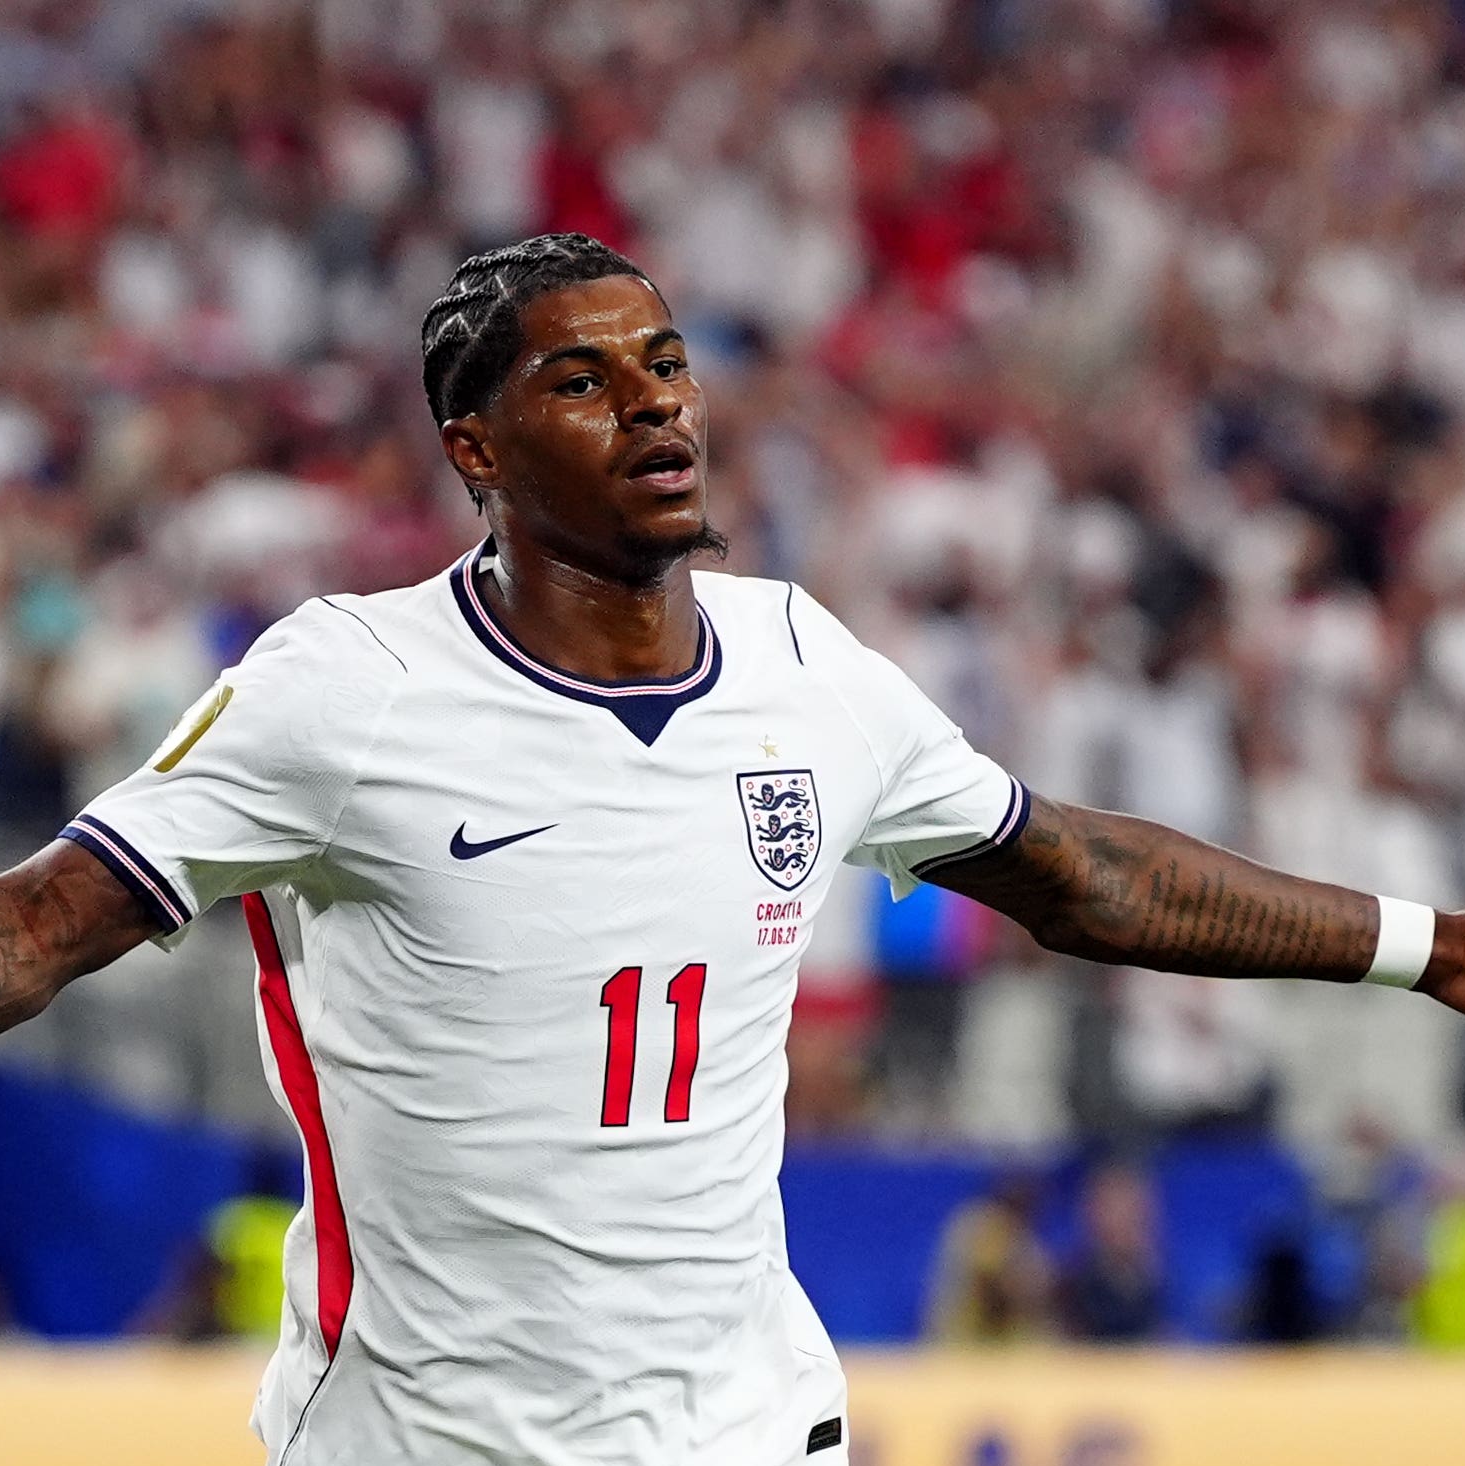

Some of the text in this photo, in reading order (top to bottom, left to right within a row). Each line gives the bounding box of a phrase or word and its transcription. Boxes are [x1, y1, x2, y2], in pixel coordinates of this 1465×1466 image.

[756, 901, 802, 921] CROATIA
[757, 926, 797, 946] 17.06.26
[599, 963, 707, 1128] 11
